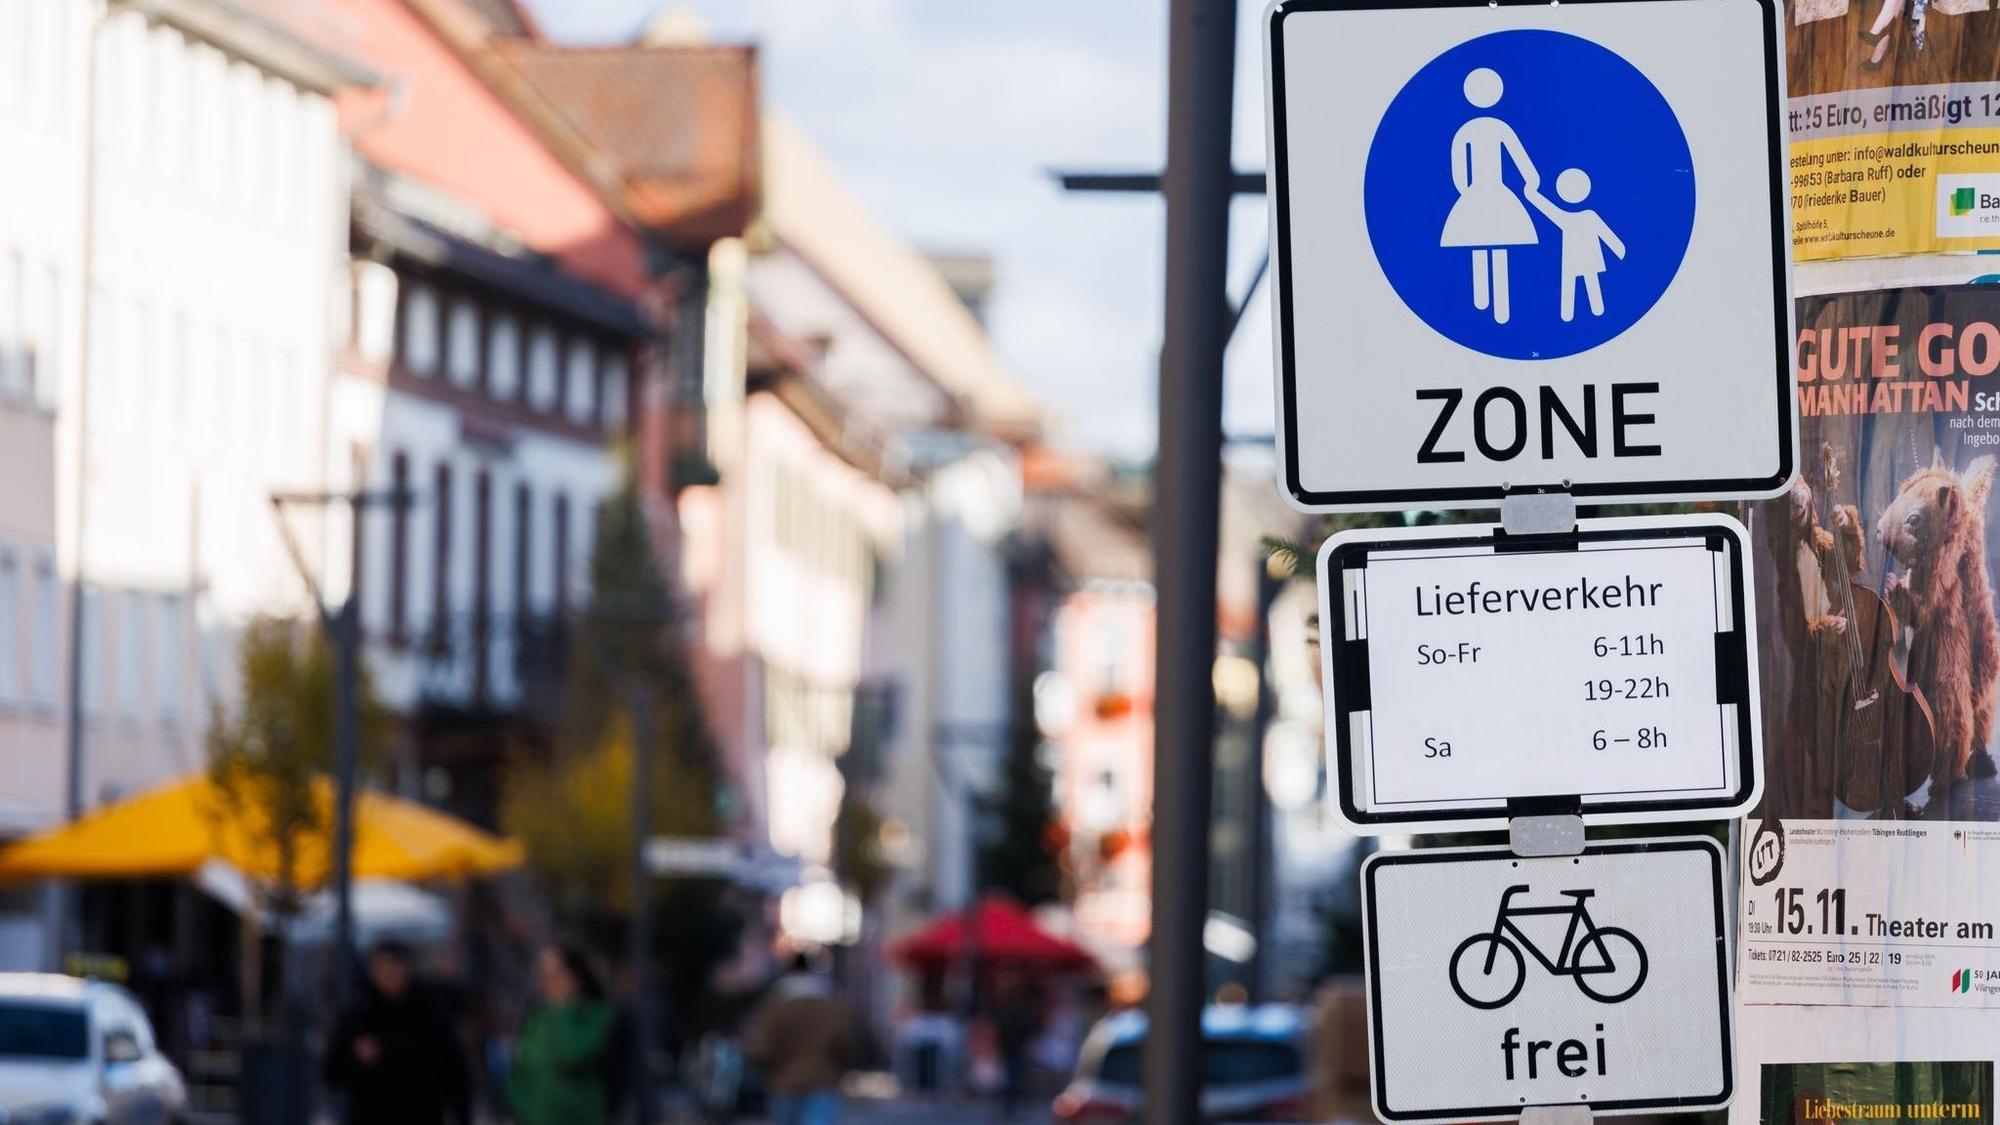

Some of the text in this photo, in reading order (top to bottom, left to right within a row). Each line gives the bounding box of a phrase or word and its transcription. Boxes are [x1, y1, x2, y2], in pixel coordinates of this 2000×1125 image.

[1827, 104, 1867, 129] Euro,
[1873, 95, 1972, 124] ermäßigt
[1824, 169, 1864, 188] (Barbara
[1867, 165, 1893, 183] Ruff)
[1897, 165, 1926, 180] oder
[1850, 186, 1886, 204] Bauer)
[1981, 194, 2000, 209] Ba
[1797, 322, 2000, 382] GUTE GO
[1798, 380, 1969, 417] MANHATTAN
[1416, 382, 1662, 464] ZONE
[1950, 415, 2000, 429] nach dem
[1964, 432, 2000, 447] Ingebo
[1416, 575, 1663, 617] Lieferverkehr
[1417, 633, 1664, 665] So-Fr 6-11h
[1584, 676, 1670, 701] 19-22h
[1424, 737, 1452, 758] Sa
[1637, 726, 1667, 749] 8h
[1775, 887, 1858, 935] 15.11.
[1865, 913, 1948, 938] Theater
[1957, 922, 1993, 939] am
[1848, 952, 1861, 964] 25
[1869, 952, 1880, 964] 22
[1888, 952, 1901, 966] 19
[1501, 1023, 1606, 1081] frei
[1804, 1098, 1981, 1120] Liebestraum unterm
